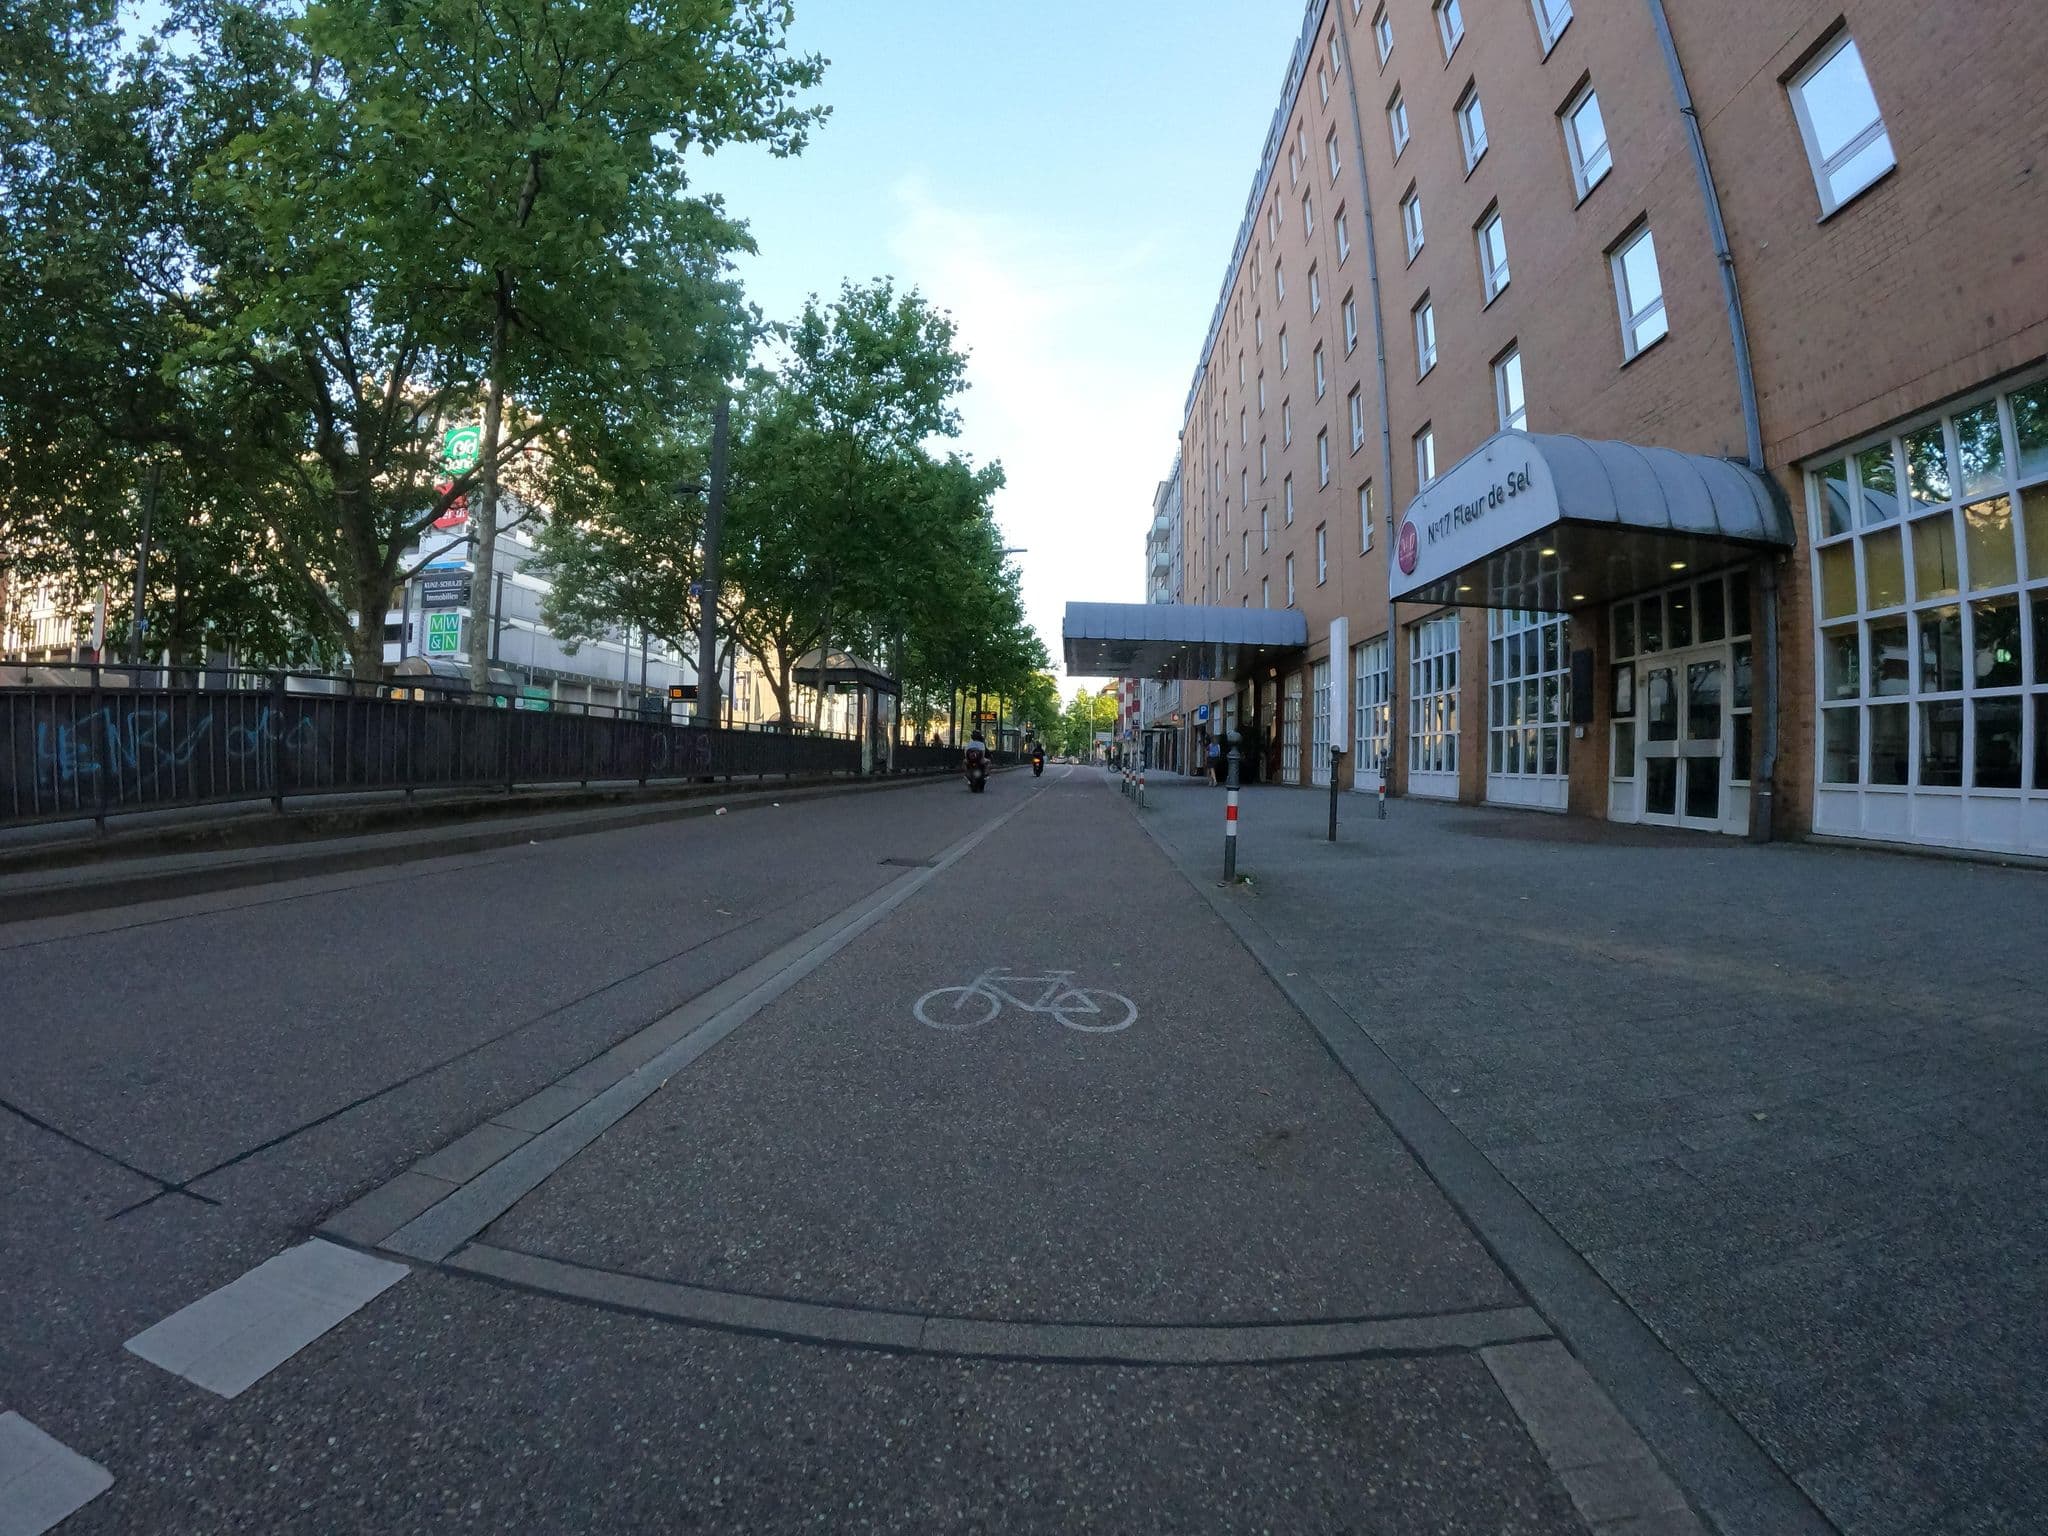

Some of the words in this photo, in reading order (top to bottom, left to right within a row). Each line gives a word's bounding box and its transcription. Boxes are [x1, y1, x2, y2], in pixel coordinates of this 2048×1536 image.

[1453, 495, 1485, 530] Fleur
[1488, 484, 1505, 509] de
[1507, 462, 1532, 497] Sel
[426, 591, 459, 602] Immobilien
